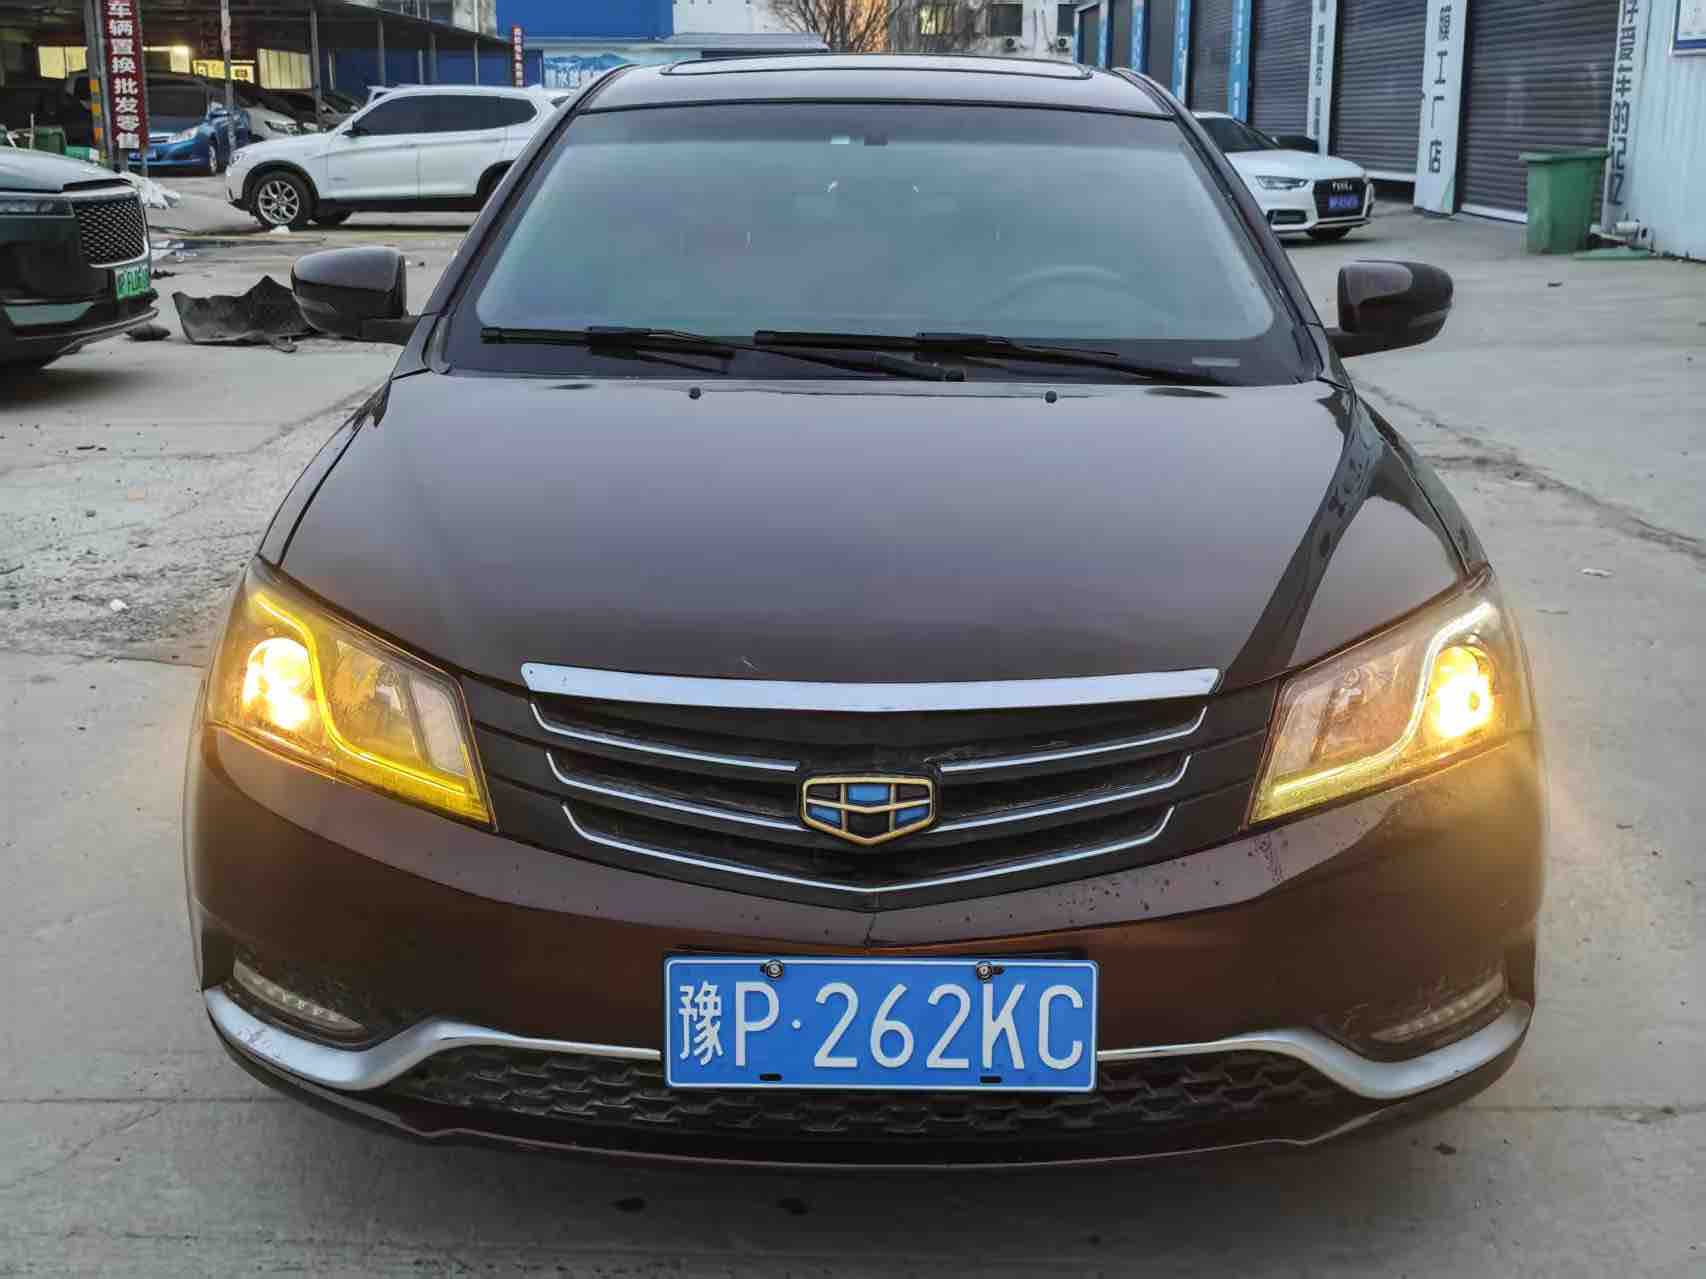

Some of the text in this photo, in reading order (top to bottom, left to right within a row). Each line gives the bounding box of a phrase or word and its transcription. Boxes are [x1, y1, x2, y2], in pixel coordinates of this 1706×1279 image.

[108, 0, 139, 149] 车辆置换批发零售
[678, 980, 1084, 1070] 豫P·262KC
